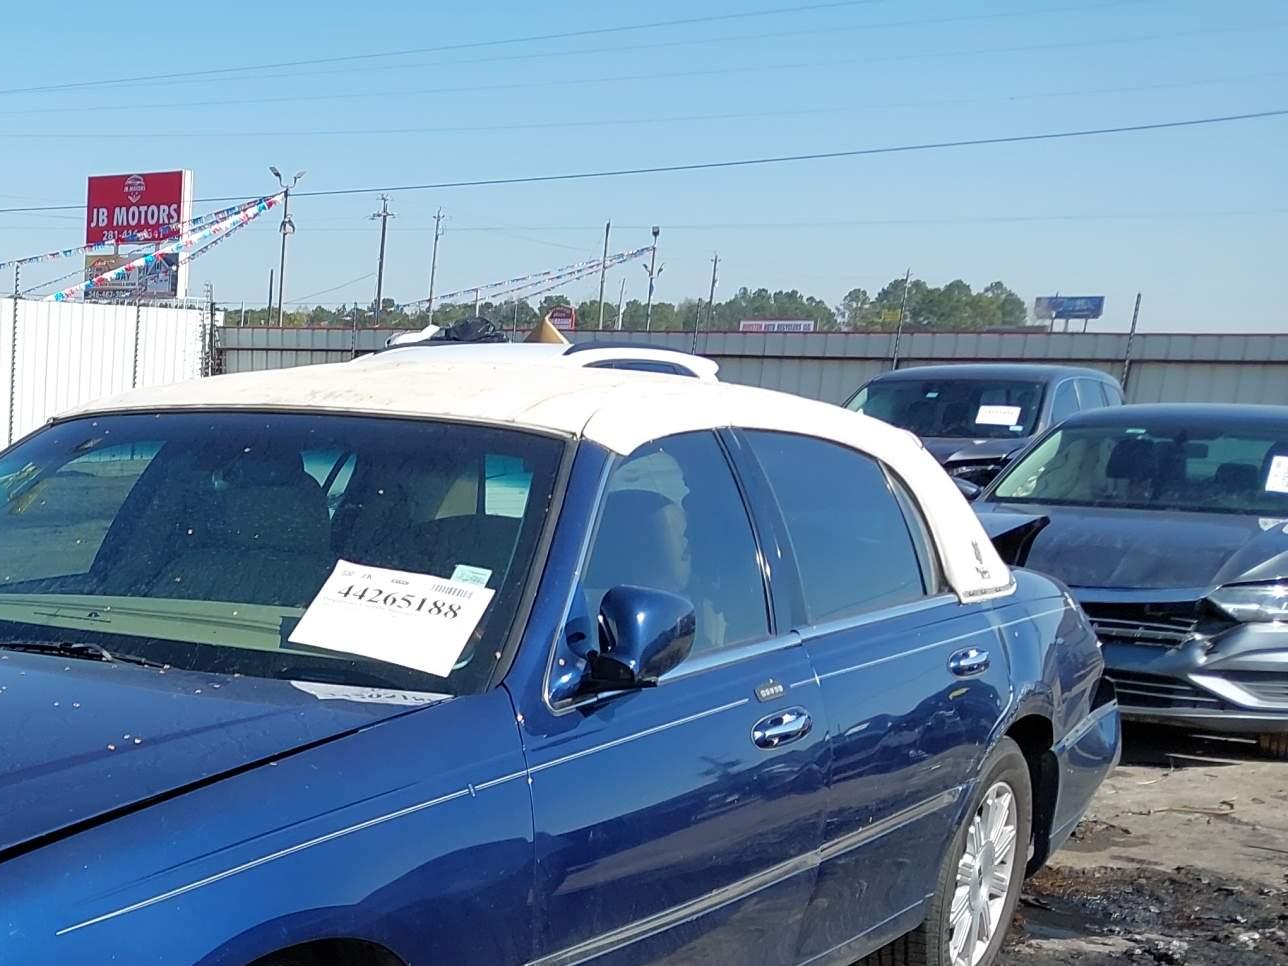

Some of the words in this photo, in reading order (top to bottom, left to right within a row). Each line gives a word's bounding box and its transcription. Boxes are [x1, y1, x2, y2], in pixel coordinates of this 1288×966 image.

[90, 208, 108, 228] JB
[113, 204, 178, 227] MOTORS
[337, 584, 462, 620] 44265188
